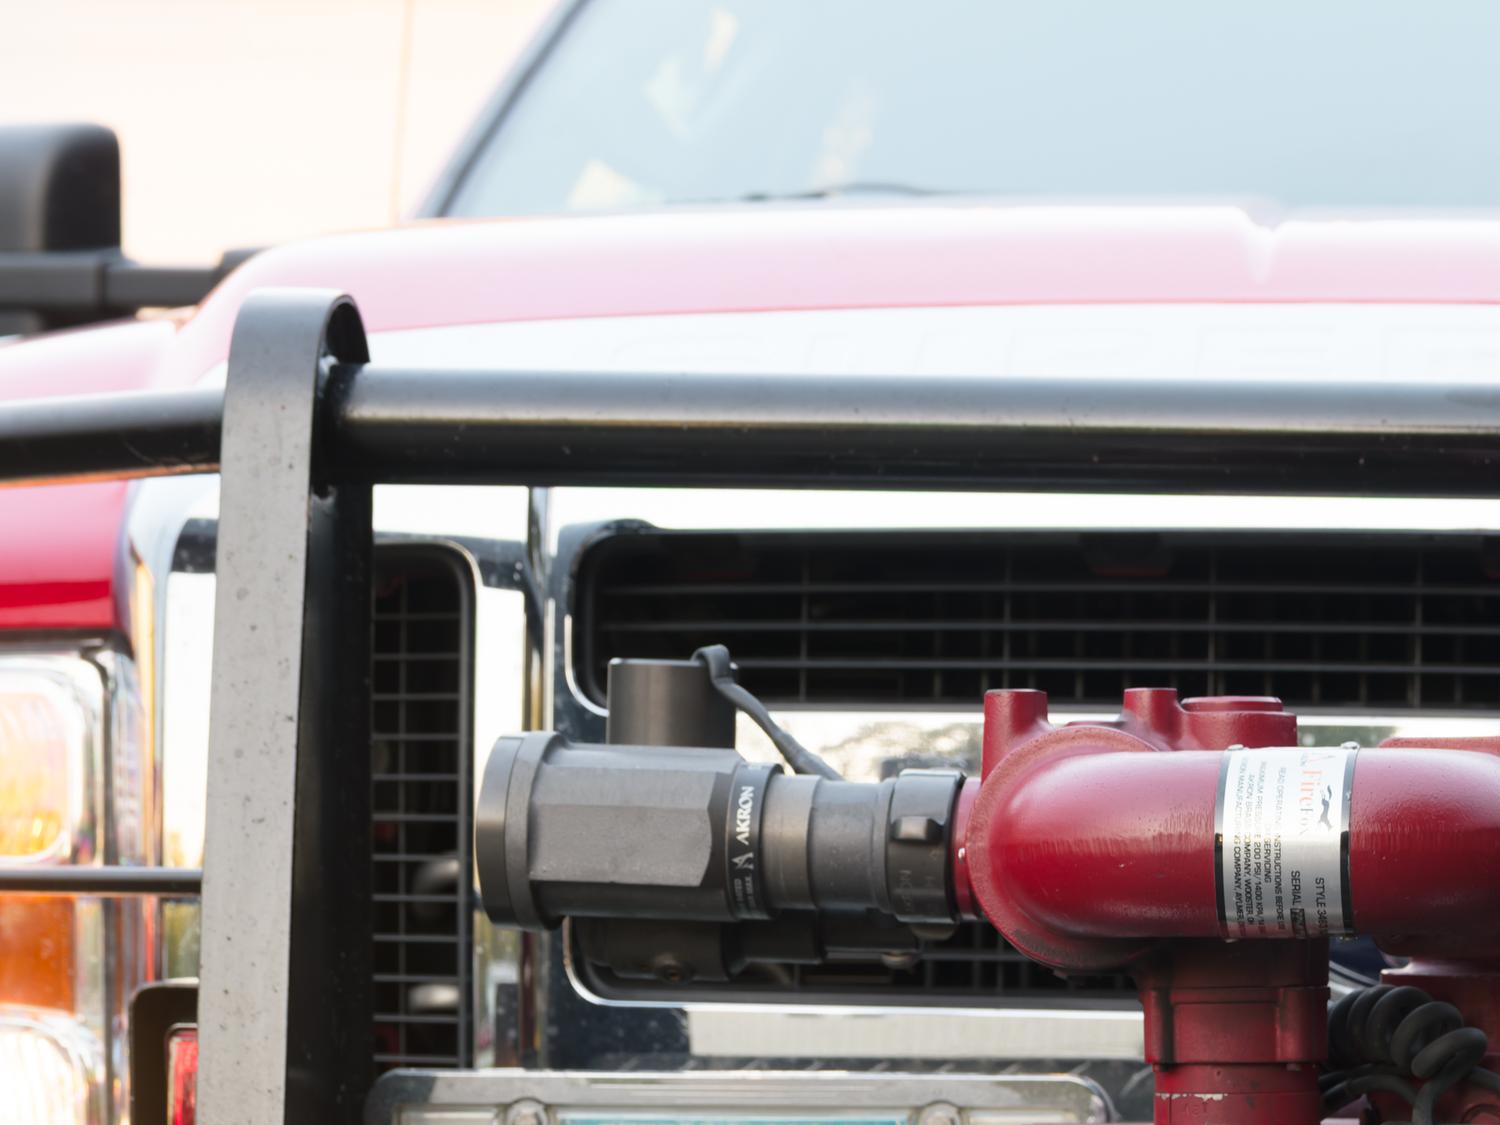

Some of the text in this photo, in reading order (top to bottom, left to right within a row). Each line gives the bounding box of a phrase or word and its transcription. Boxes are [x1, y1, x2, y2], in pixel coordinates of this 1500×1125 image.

[736, 785, 756, 845] AKRON
[1233, 846, 1241, 889] COMPANY,
[1291, 870, 1301, 905] SERIAL
[1315, 877, 1325, 908] STYLE
